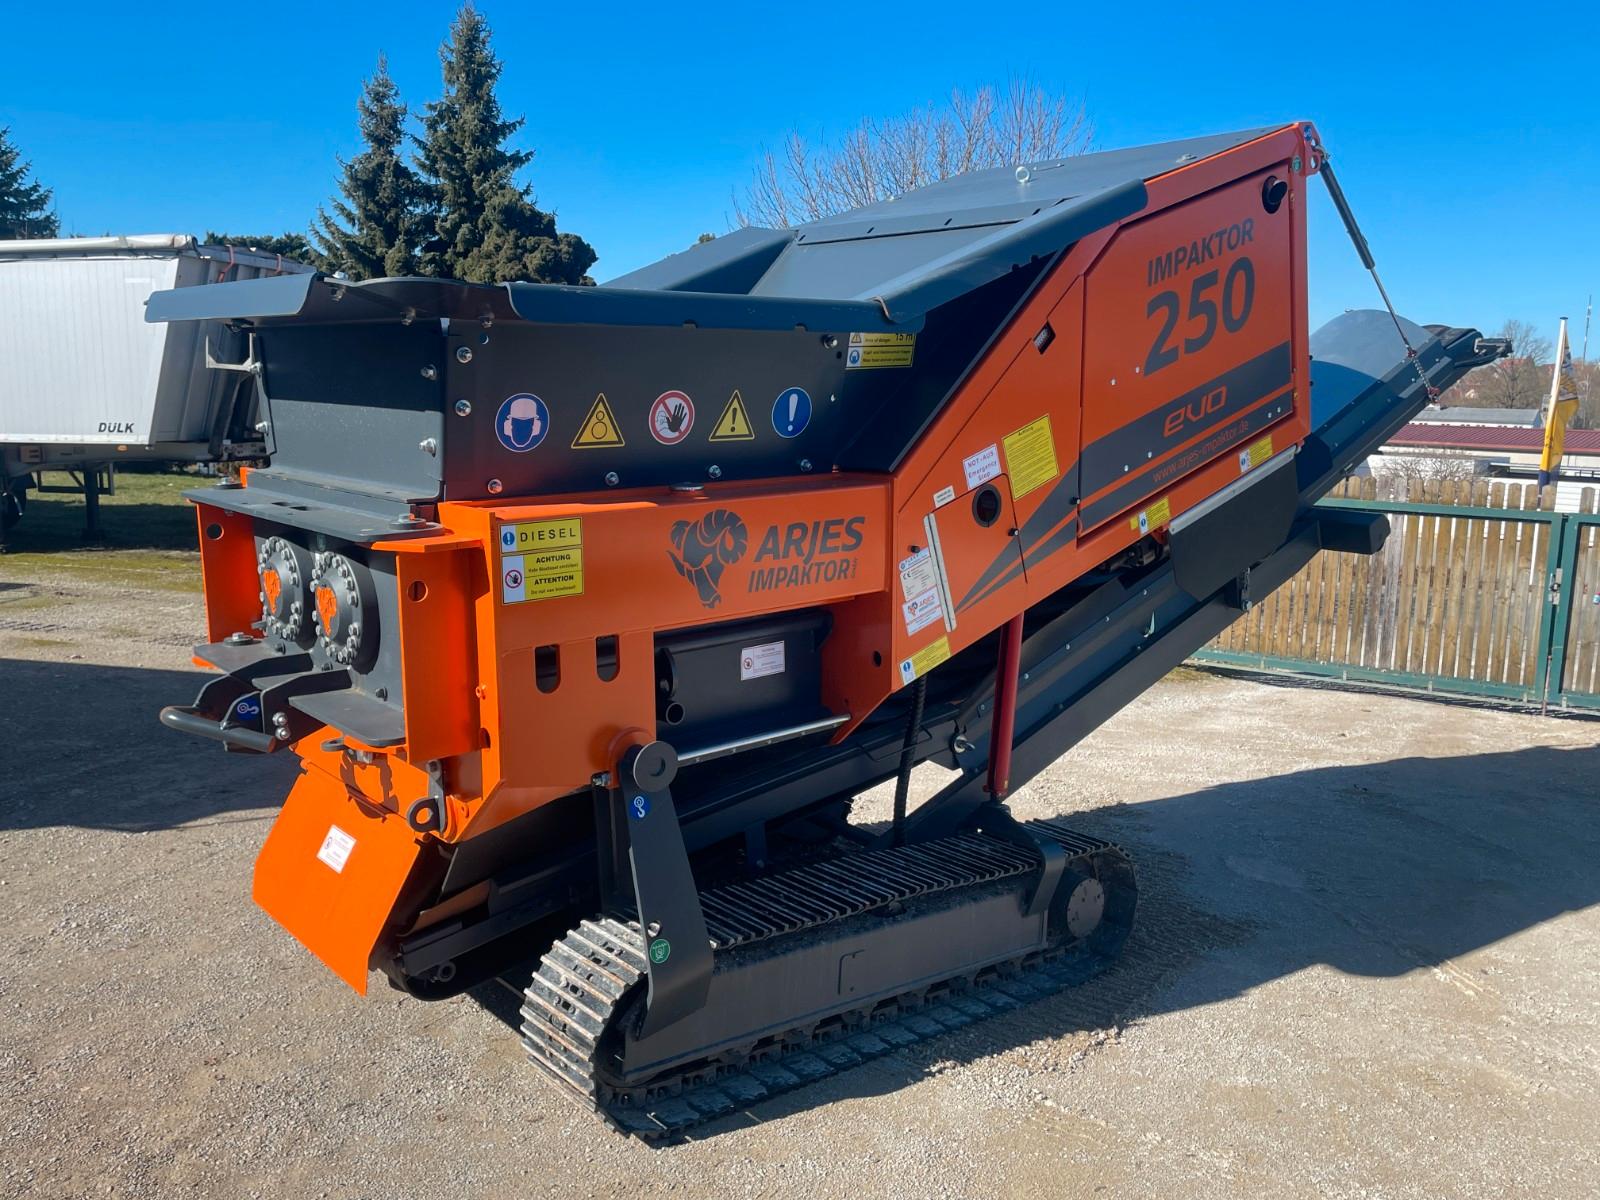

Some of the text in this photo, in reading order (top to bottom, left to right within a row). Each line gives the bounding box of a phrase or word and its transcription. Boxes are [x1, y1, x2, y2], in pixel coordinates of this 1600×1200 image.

[1147, 217, 1254, 287] IMPAKTOR
[1143, 256, 1255, 377] 250
[968, 460, 997, 479] Emergency
[520, 527, 576, 542] DIESEL
[753, 516, 866, 565] ARJES
[535, 553, 571, 564] ACHTUNG
[534, 574, 574, 586] ATTENTION
[747, 558, 851, 593] IMPAKTOR
